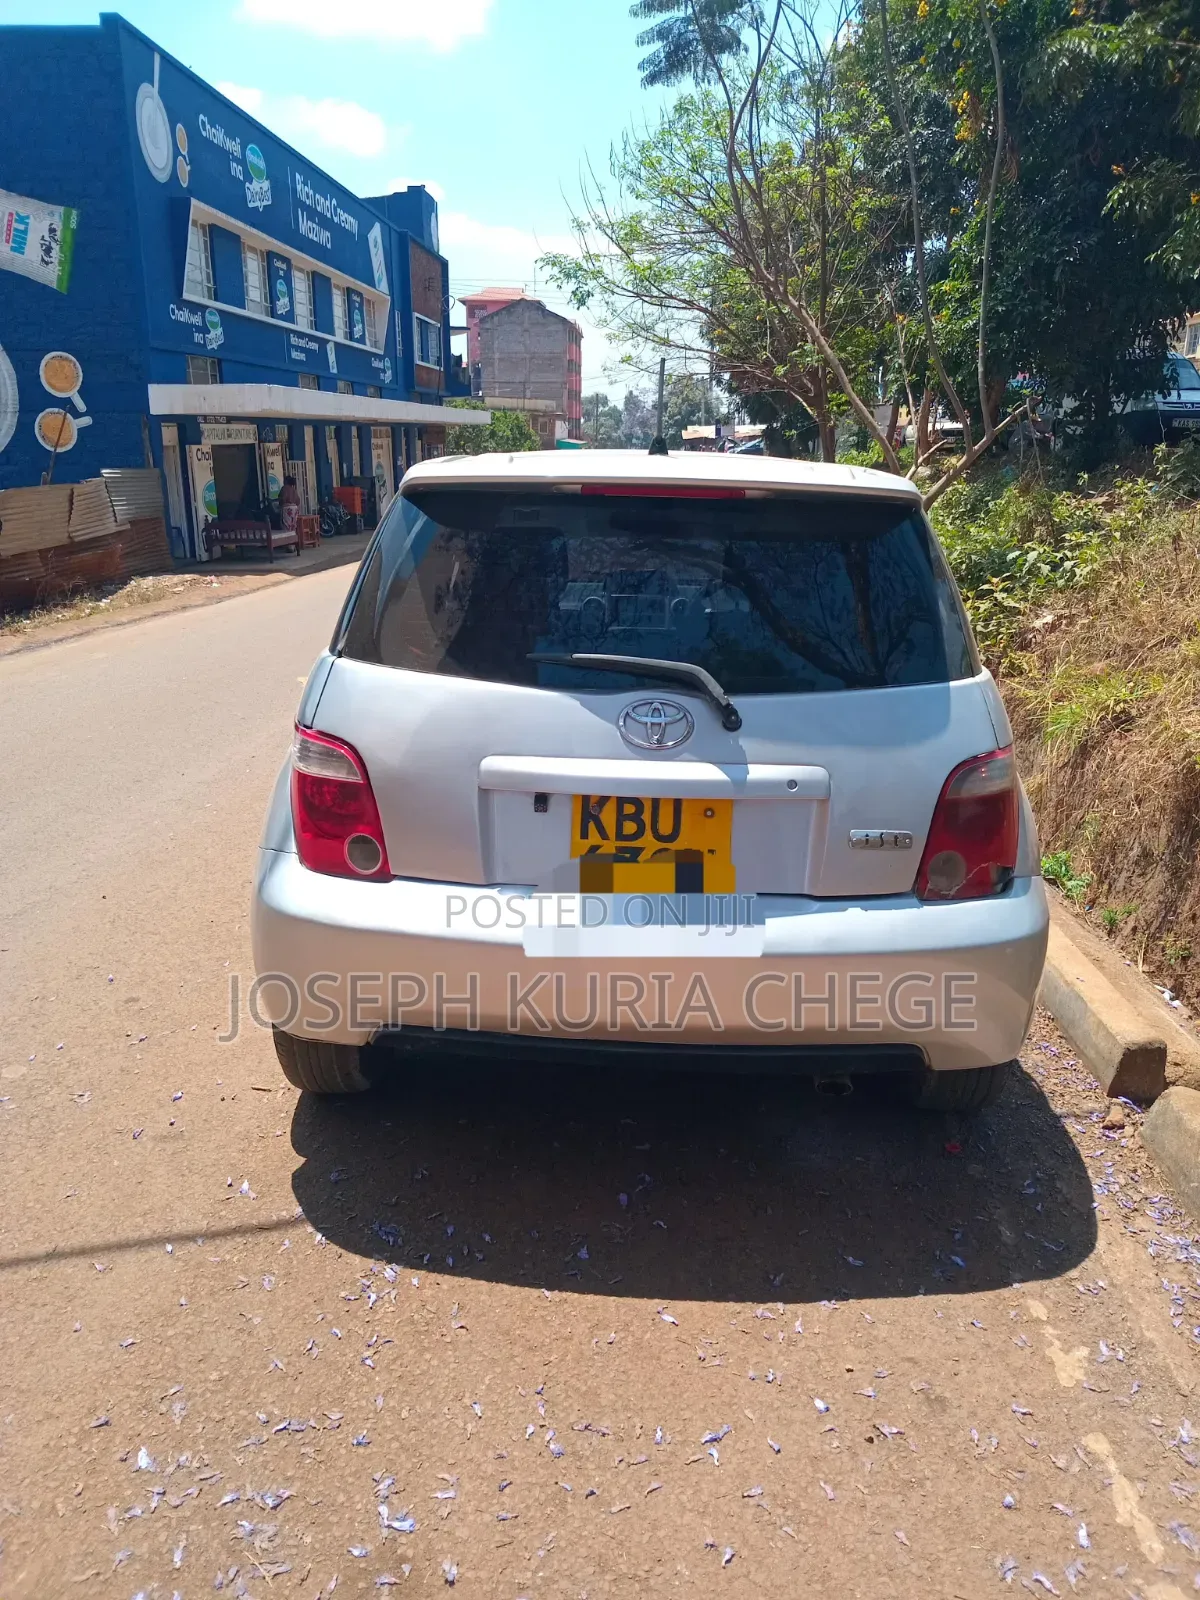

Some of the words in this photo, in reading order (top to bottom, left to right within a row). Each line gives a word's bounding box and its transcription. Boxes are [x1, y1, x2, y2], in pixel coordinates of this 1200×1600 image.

[199, 114, 242, 159] ChaiKweli
[230, 154, 243, 181] ina
[296, 172, 315, 208] Rich
[315, 193, 332, 219] and
[331, 197, 358, 241] Creamy
[298, 208, 332, 250] Maziwa
[10, 211, 31, 256] MILK
[196, 447, 212, 462] Chai
[580, 794, 683, 844] KBU
